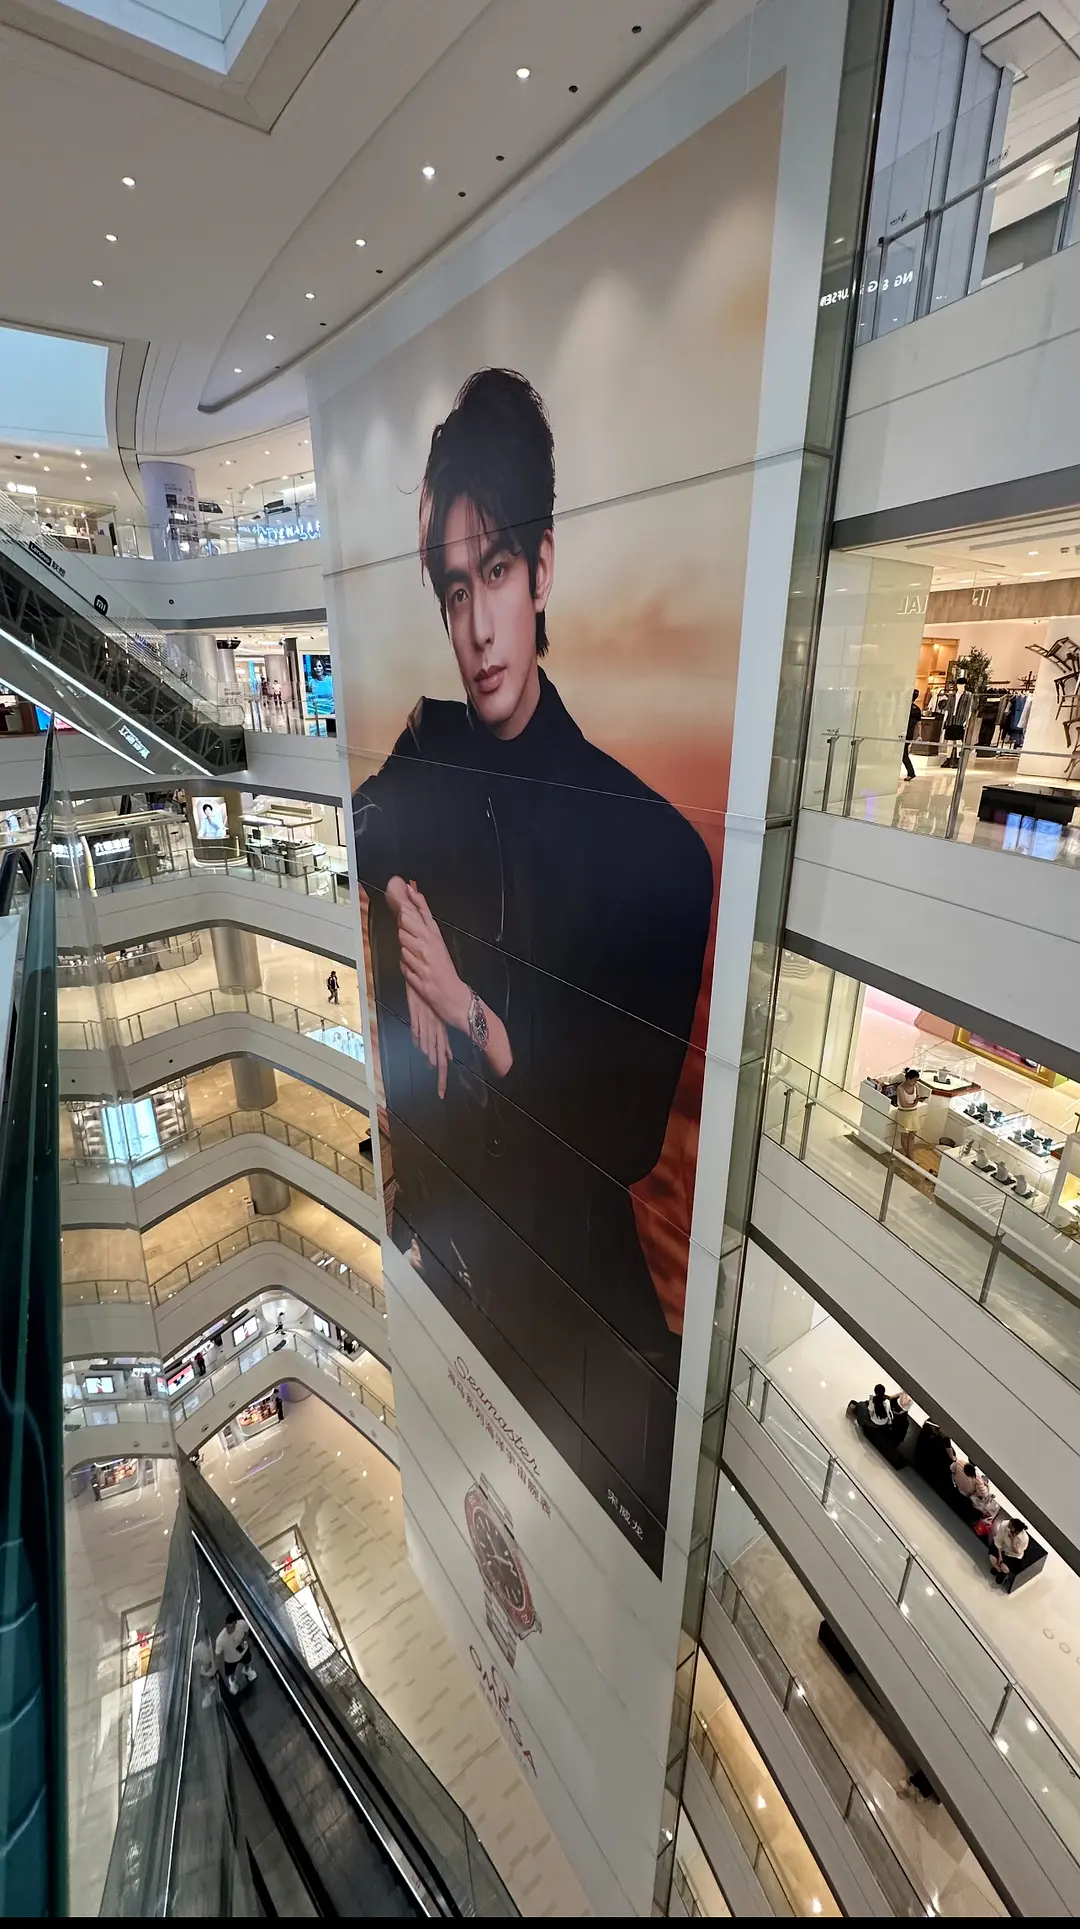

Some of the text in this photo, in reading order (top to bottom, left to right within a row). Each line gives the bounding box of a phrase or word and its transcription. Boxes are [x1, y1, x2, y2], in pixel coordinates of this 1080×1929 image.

[29, 543, 51, 565] Lenovo
[454, 1356, 540, 1476] Seamaster
[469, 1645, 538, 1778] OMEGA
